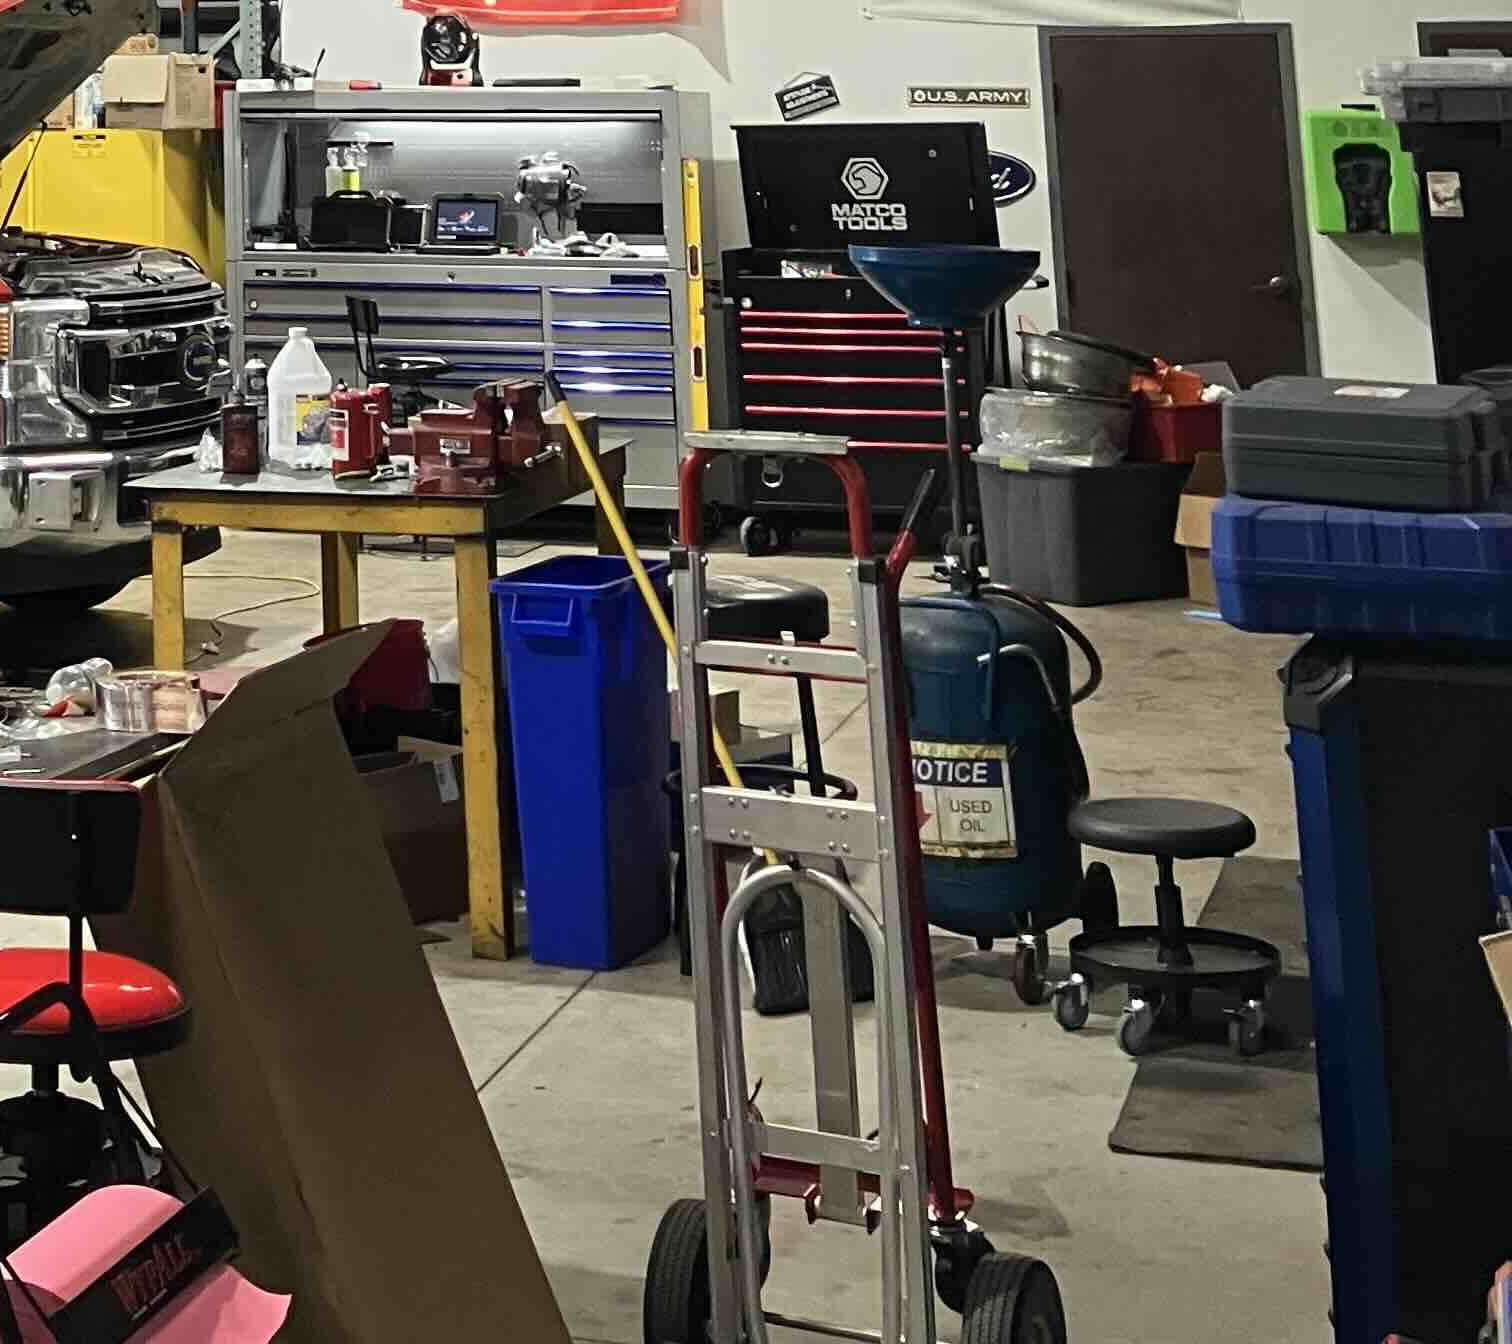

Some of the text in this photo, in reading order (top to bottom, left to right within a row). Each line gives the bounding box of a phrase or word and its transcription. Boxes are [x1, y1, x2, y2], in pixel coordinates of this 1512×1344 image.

[926, 89, 1023, 103] U.S. ARMY
[830, 203, 907, 216] MATCO
[832, 217, 908, 230] TOOLS
[949, 799, 993, 814] USED
[959, 818, 985, 833] OIL
